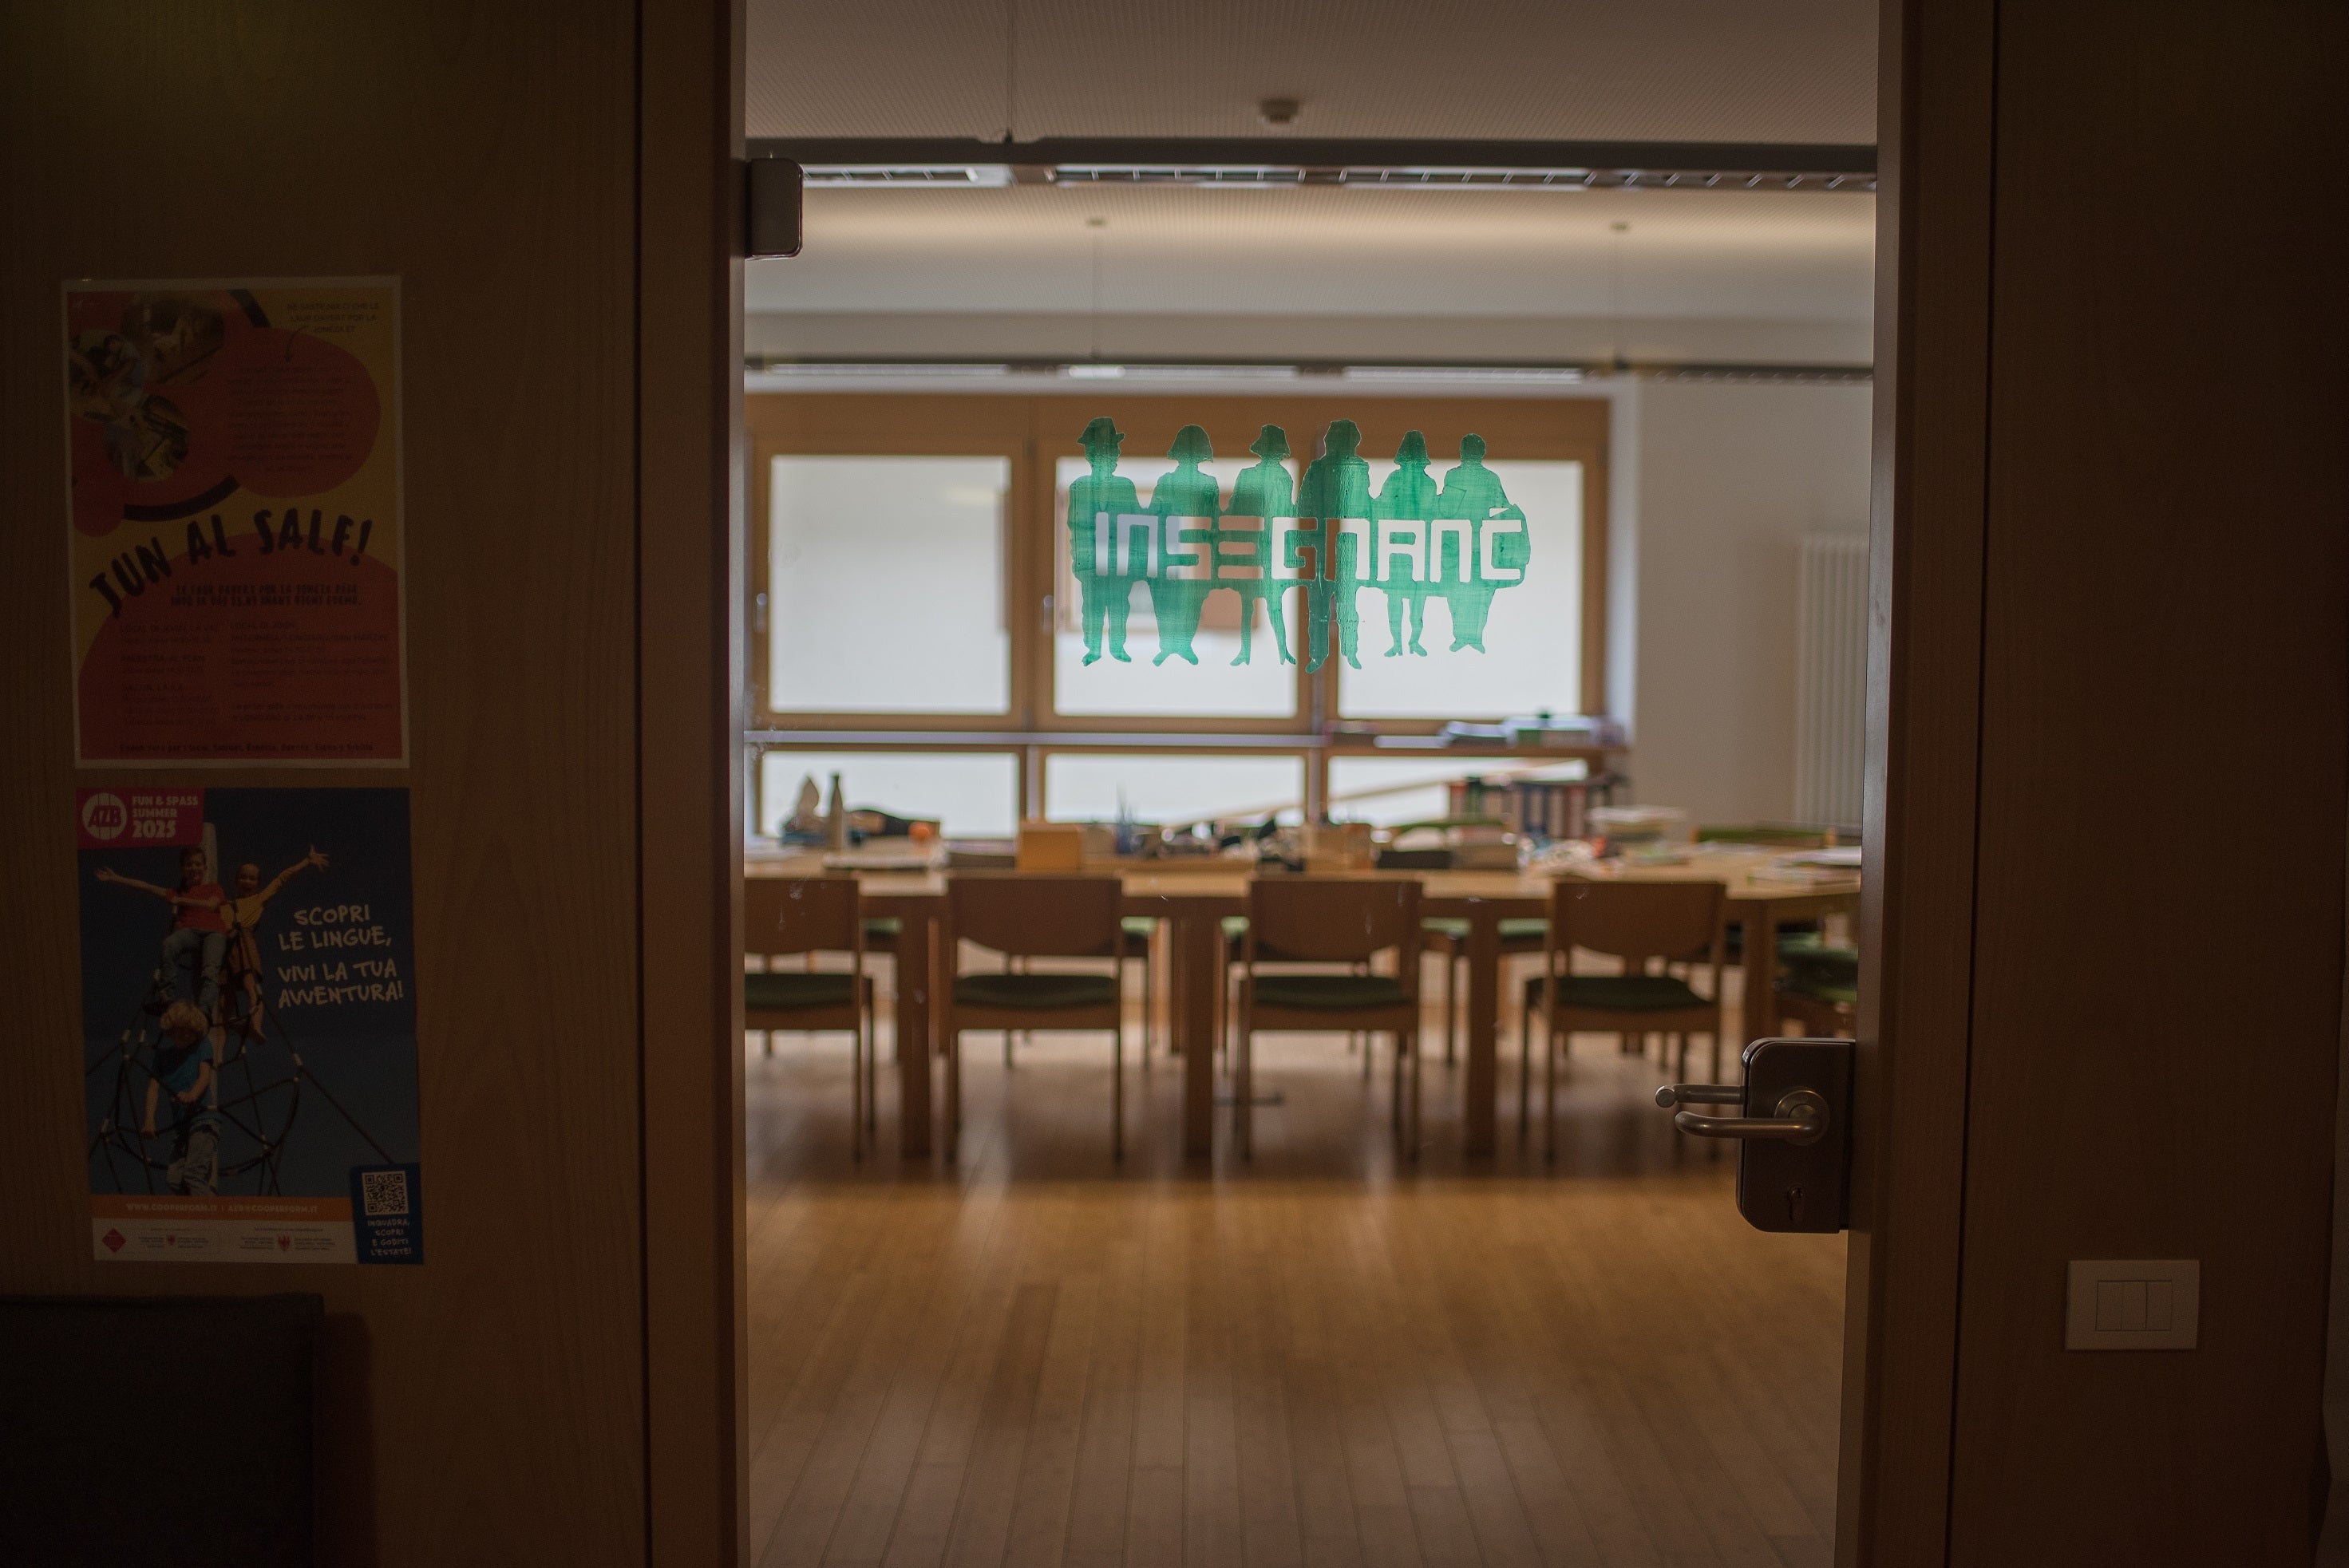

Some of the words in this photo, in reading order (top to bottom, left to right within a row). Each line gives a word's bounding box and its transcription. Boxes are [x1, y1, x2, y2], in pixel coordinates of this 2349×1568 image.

[186, 514, 236, 566] AL
[132, 796, 153, 806] FUN
[166, 796, 198, 806] SPASS
[132, 808, 178, 818] SUMMER
[132, 820, 176, 838] 2025
[294, 904, 370, 926] SCOPRI
[278, 931, 305, 951] LE
[310, 926, 392, 949] LINGUE,
[277, 964, 316, 983] VIVI
[322, 962, 348, 981] LA
[352, 958, 397, 979] TUA
[278, 981, 404, 1009] AVVENTURA!
